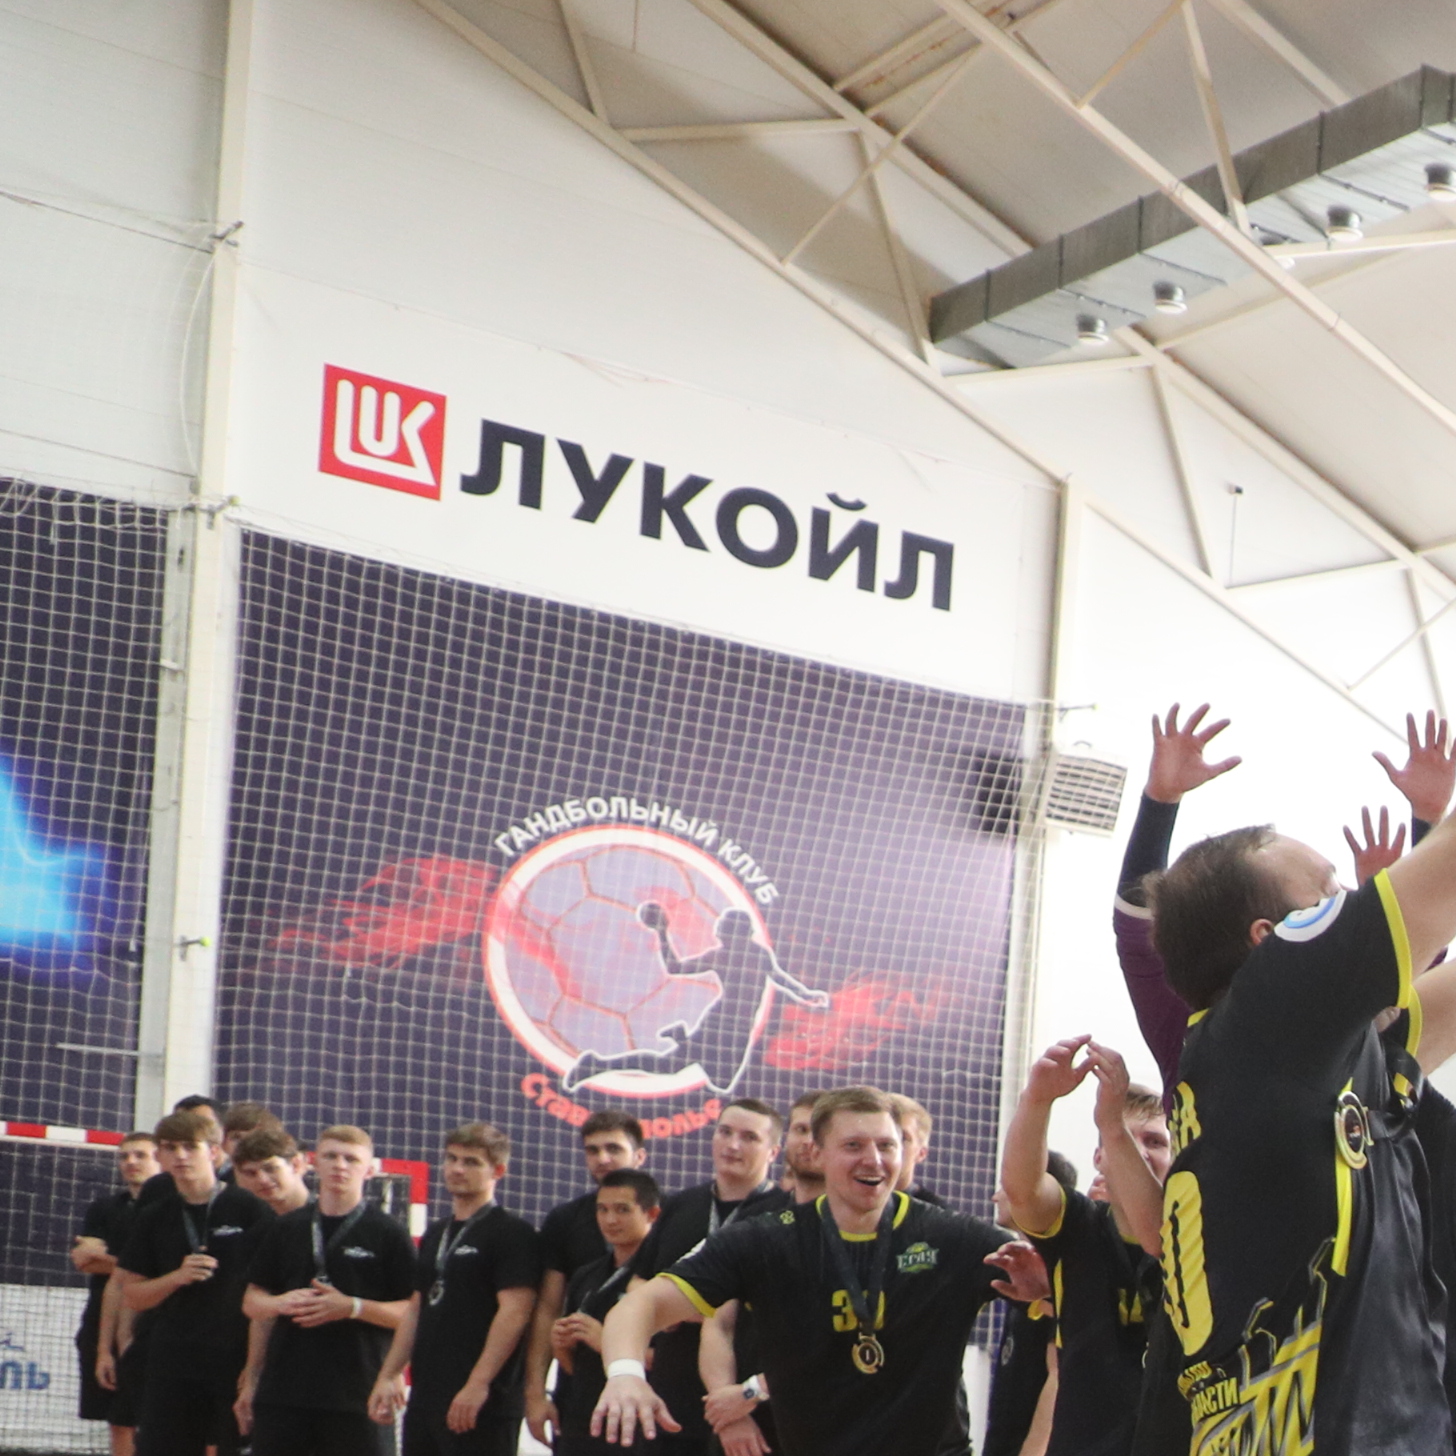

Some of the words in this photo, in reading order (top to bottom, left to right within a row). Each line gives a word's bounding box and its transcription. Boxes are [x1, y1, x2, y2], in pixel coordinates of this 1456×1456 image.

[460, 418, 954, 612] ЛУКОЙЛ
[494, 796, 718, 857] ГАНДБОЛЬНЫЙ
[718, 838, 779, 905] КЛУБ
